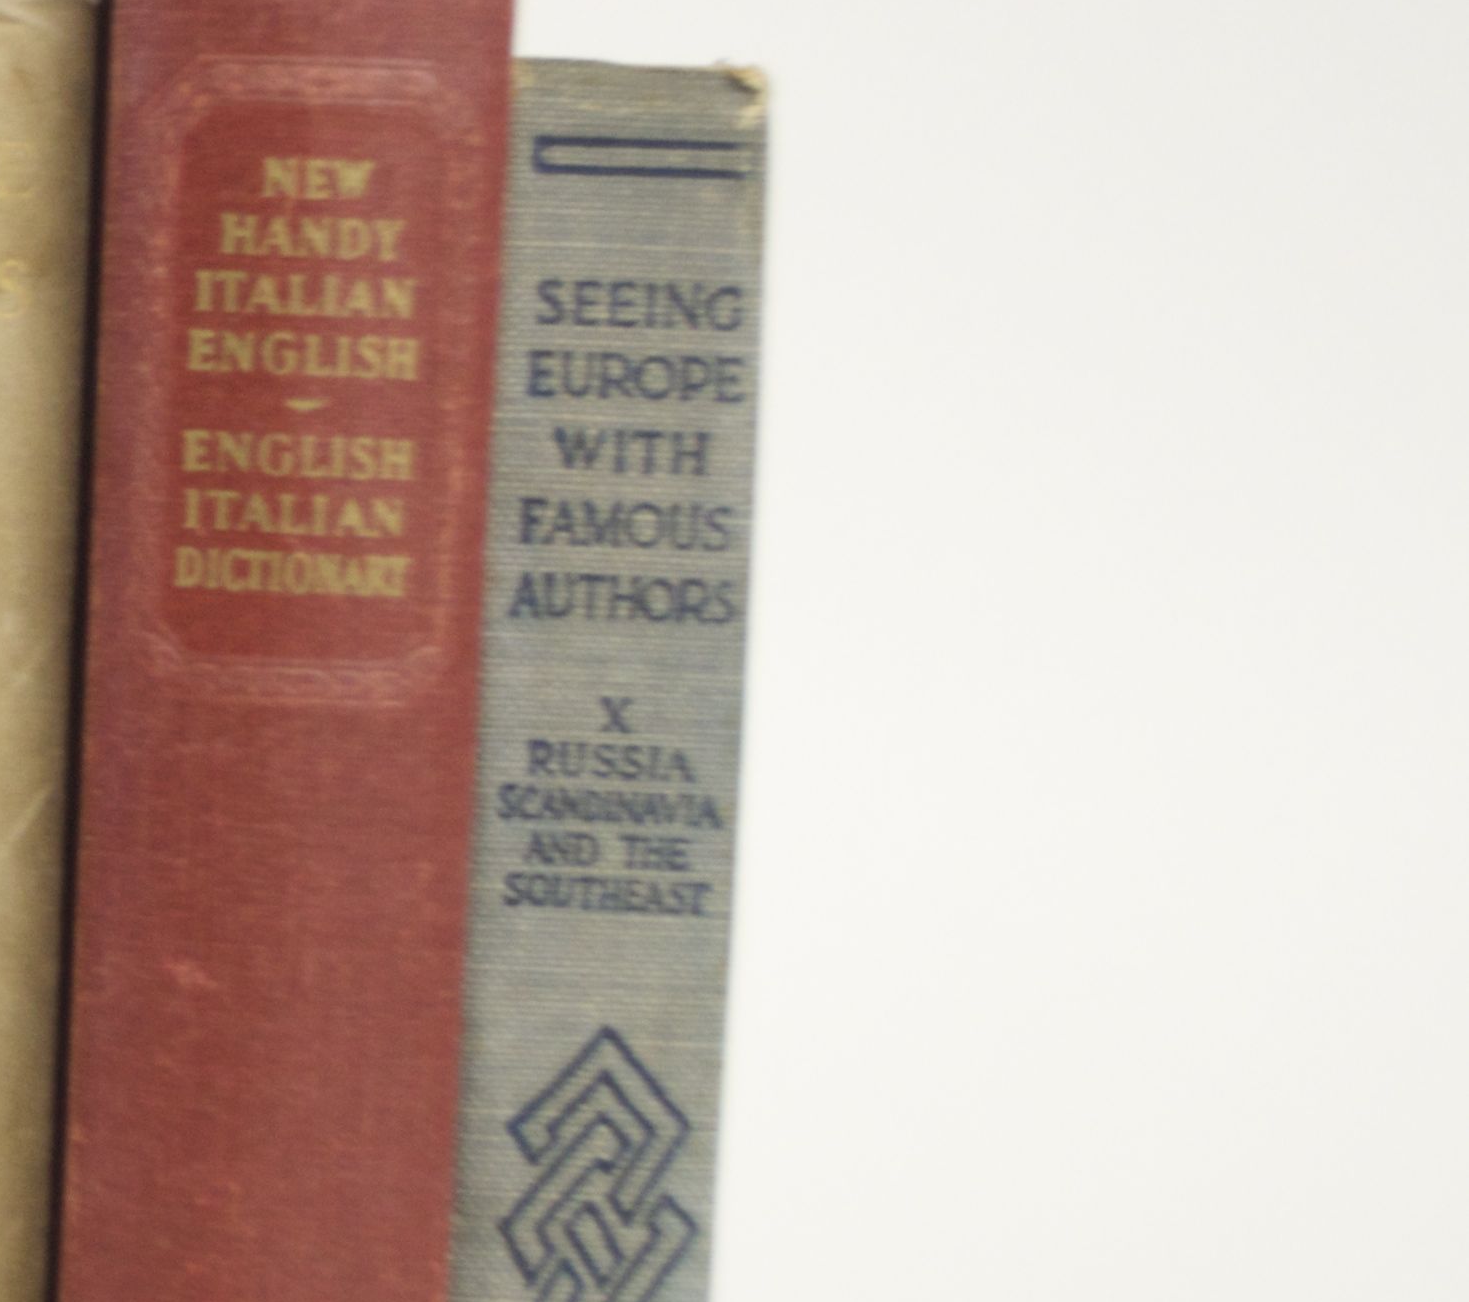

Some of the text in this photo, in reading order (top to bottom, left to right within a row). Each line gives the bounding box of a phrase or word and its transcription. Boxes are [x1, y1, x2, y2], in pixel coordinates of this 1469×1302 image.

[263, 156, 376, 201] NEW
[220, 212, 406, 263] HANDY
[194, 269, 418, 320] ITALIAN
[537, 278, 743, 331] SEEING
[186, 328, 419, 381] ENGLISH
[527, 349, 745, 402] EUROPE
[181, 429, 416, 481] ENGLISH
[553, 425, 710, 476] WITH
[182, 488, 403, 539] ITALIAN
[519, 497, 733, 552] FAMOUS
[174, 546, 412, 599] DICTIONARY
[509, 571, 736, 624] AUTHORS
[600, 696, 634, 734] X
[527, 738, 696, 783] RUSSIA
[522, 832, 601, 867] AND
